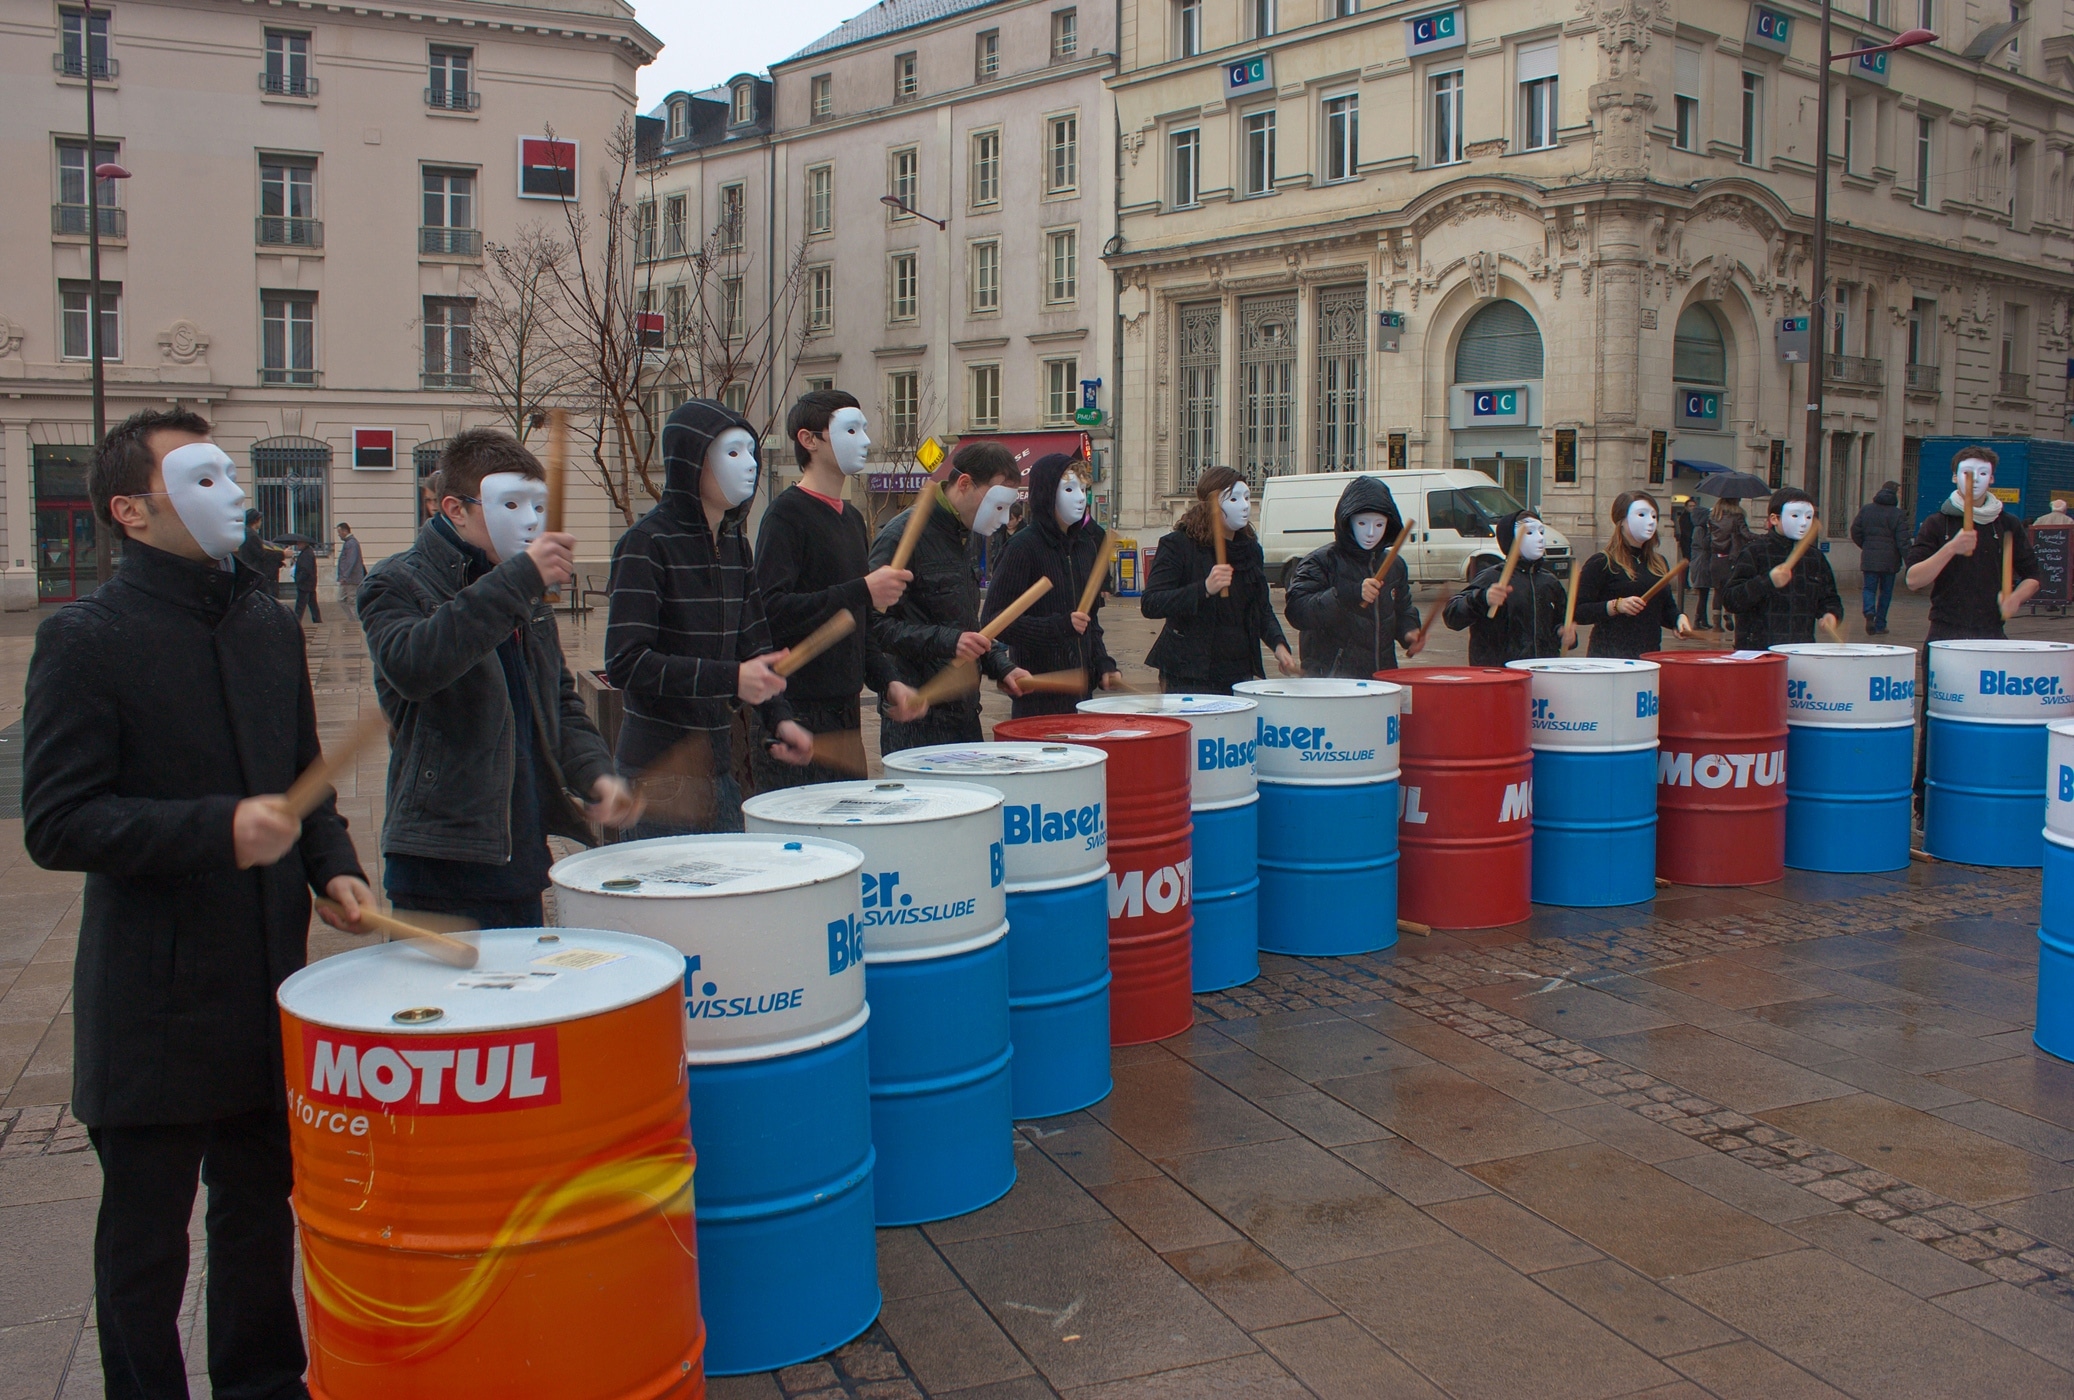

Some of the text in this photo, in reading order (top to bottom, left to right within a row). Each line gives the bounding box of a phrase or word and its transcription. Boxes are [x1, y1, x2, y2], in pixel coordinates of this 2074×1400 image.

[1417, 17, 1450, 39] CIC
[1761, 16, 1785, 37] CIC
[1232, 63, 1261, 83] CIC
[1382, 316, 1398, 326] CIC
[1784, 320, 1805, 330] CIC
[1478, 394, 1511, 412] CIC
[1689, 397, 1714, 414] CIC
[1084, 434, 1092, 462] TABAC
[928, 451, 944, 471] PRESSE
[1979, 670, 2063, 696] Blaser.
[1789, 699, 1853, 712] SWISSLUBE
[1257, 716, 1333, 751] laser.
[1532, 719, 1598, 732] SWISSLUBE
[1300, 749, 1375, 762] SWISSLUBE
[1657, 750, 1785, 789] MOTUL
[1003, 803, 1104, 845] Blaser.
[863, 898, 976, 927] SWISSLUBE
[311, 1039, 547, 1105] MOTUL
[296, 1094, 369, 1137] force
